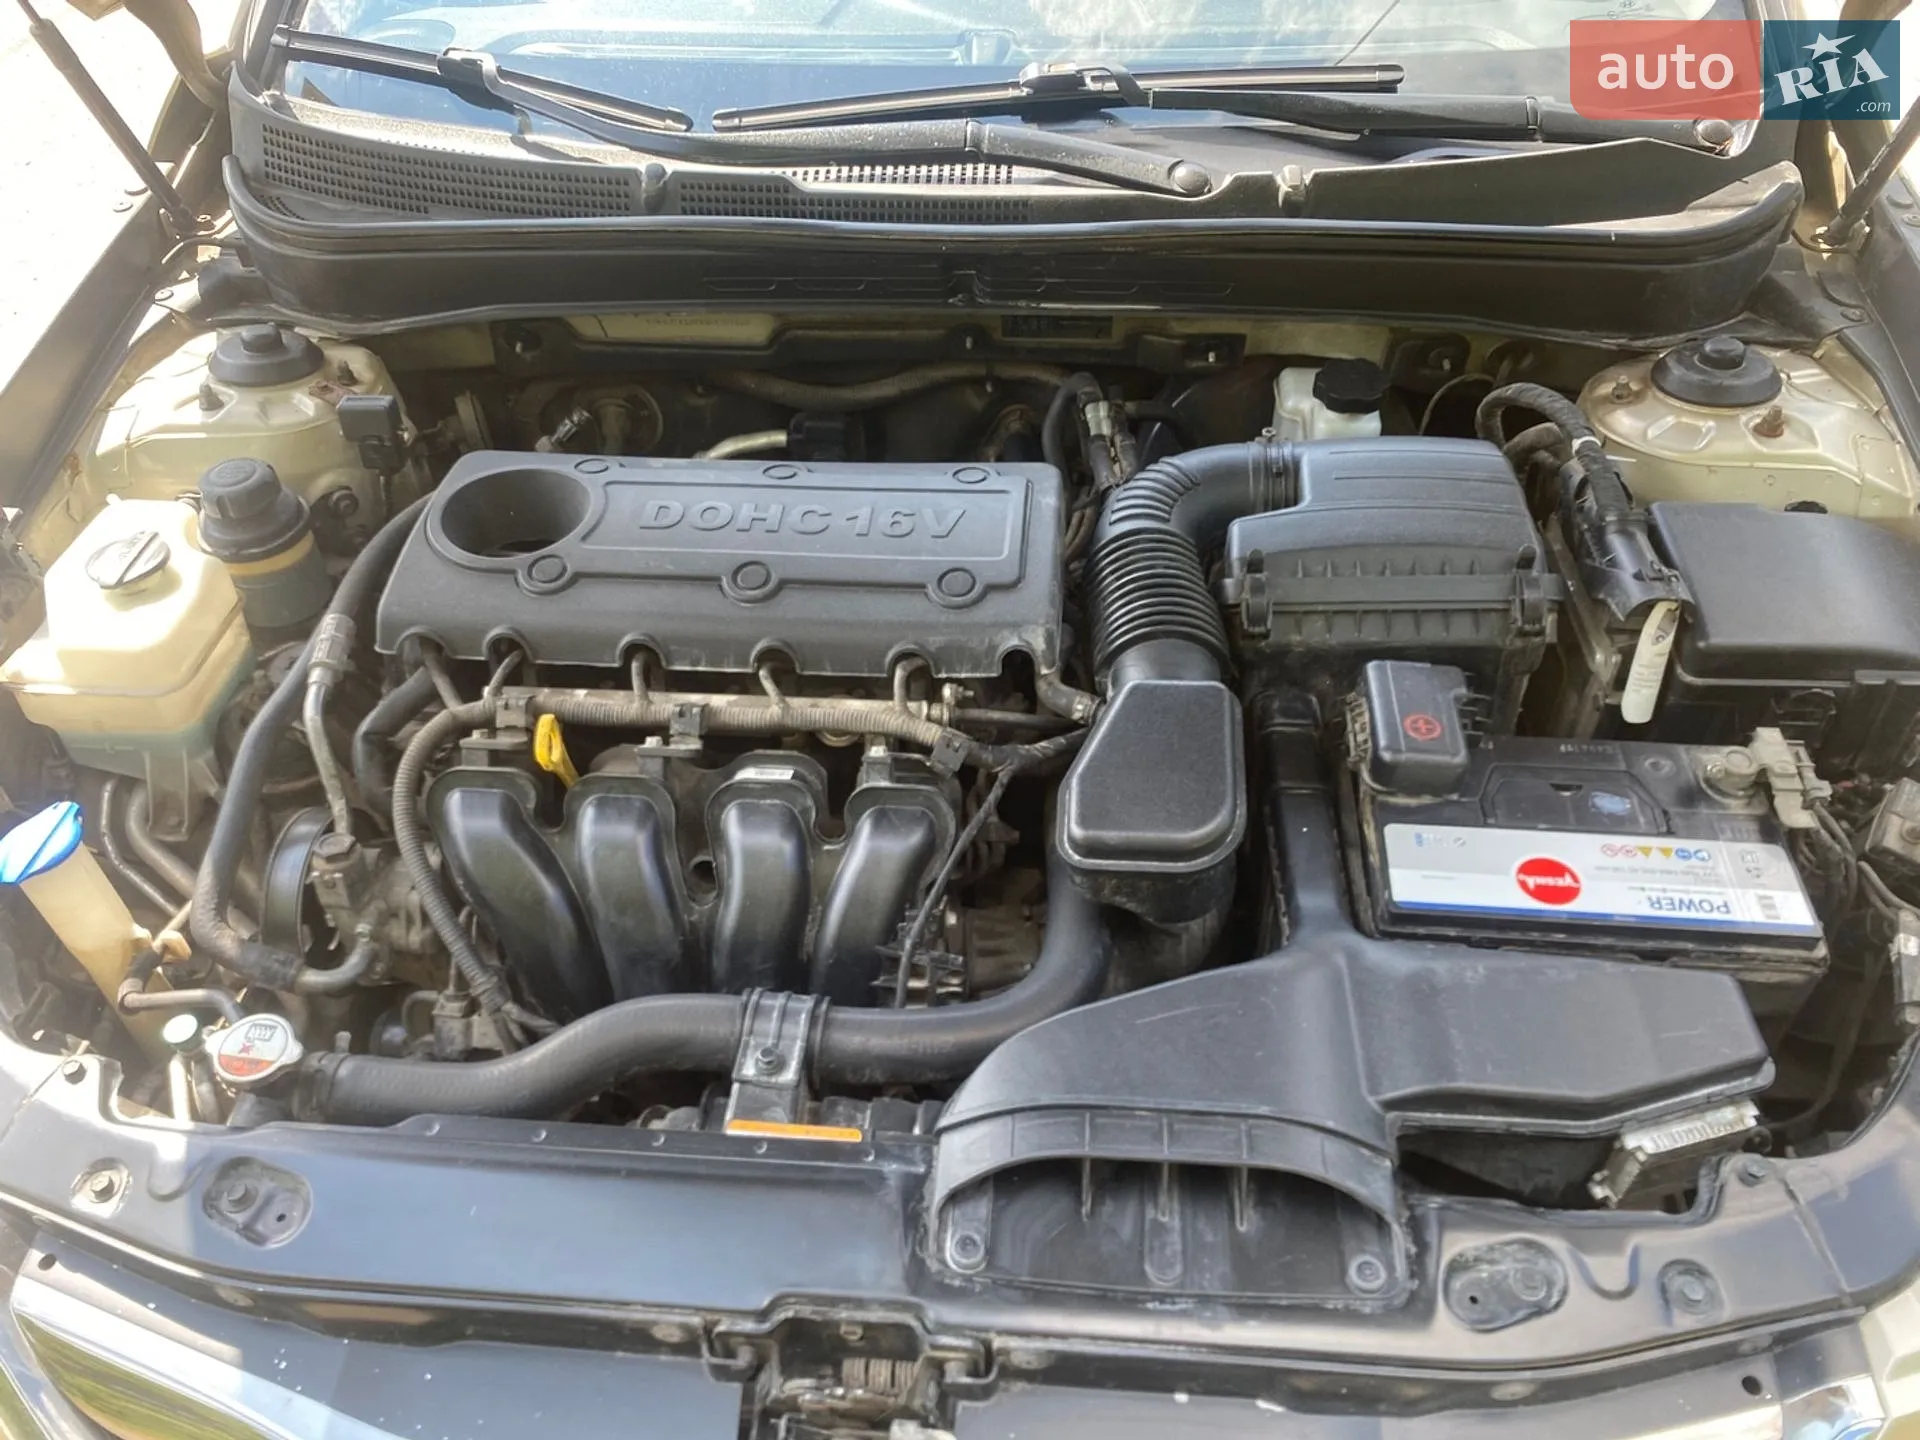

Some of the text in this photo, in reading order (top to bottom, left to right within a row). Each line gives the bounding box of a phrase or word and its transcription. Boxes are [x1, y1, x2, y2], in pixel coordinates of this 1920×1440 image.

[639, 499, 967, 539] DOHC 16V
[1647, 896, 1732, 915] POWER
